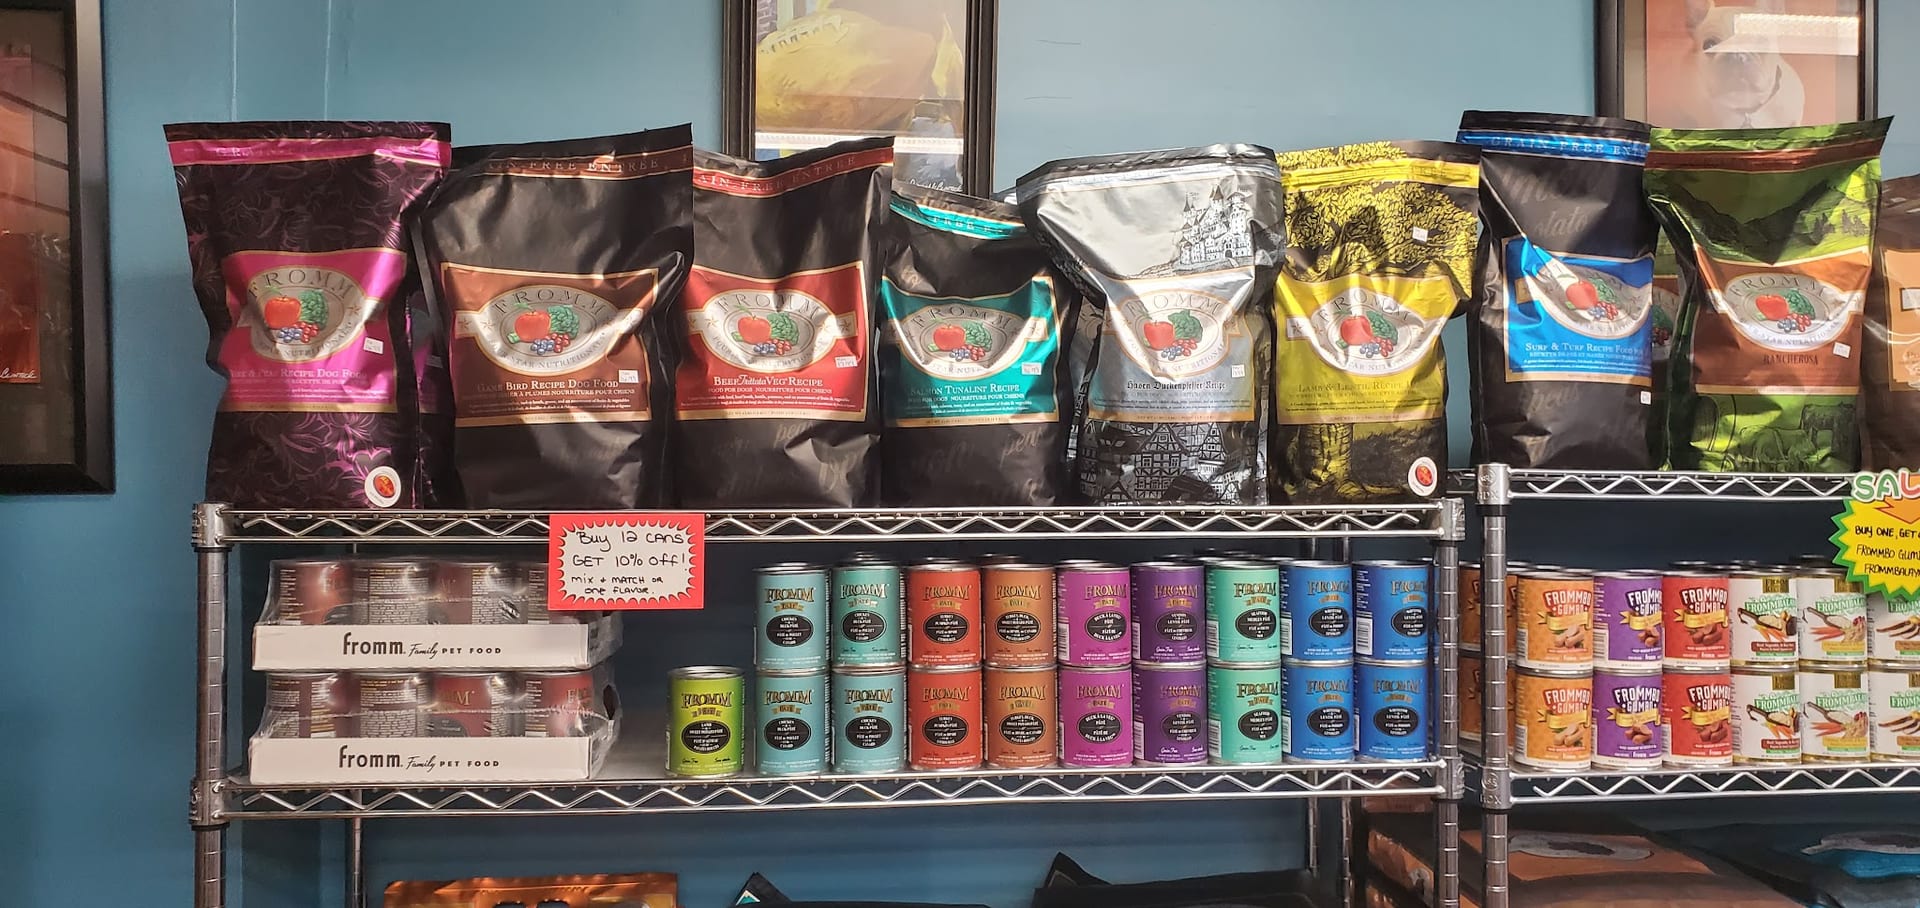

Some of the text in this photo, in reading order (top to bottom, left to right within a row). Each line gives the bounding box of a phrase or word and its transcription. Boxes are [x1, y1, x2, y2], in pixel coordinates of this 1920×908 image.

[248, 269, 354, 299] FROMM
[1729, 275, 1828, 298] FROMM
[494, 288, 607, 316] FROMM
[715, 293, 820, 319] FROMM
[912, 305, 1012, 330] FROMM
[506, 381, 528, 391] BIRD
[531, 379, 565, 390] RECIPE
[568, 379, 591, 388] DOG
[594, 379, 619, 388] FOOD
[789, 376, 823, 386] RECIPE
[621, 530, 638, 543] 12
[1855, 525, 1872, 538] BUY
[1899, 528, 1916, 539] GET
[1857, 544, 1895, 559] FROMMBO
[572, 554, 604, 567] GET
[615, 553, 643, 567] 10%
[764, 587, 815, 603] FROMM
[923, 584, 970, 601] FROMM
[993, 584, 1042, 600] FROMM
[1085, 584, 1127, 600] FROMM
[1545, 590, 1592, 607] FROMMBO
[1682, 588, 1728, 605] FROMMBO
[343, 632, 403, 655] fromm
[408, 642, 440, 660] Family
[681, 691, 732, 708] FROMM
[764, 689, 812, 705] FROMM
[844, 688, 893, 704] FROMM
[922, 687, 970, 703] FROMM
[998, 685, 1047, 701] FROMM
[1077, 684, 1122, 700] FROMM
[1545, 689, 1591, 705] FROMMBO
[1615, 688, 1660, 703] FROMMBO
[339, 745, 401, 768] fromm
[405, 755, 437, 771] Family
[439, 760, 461, 768] PET
